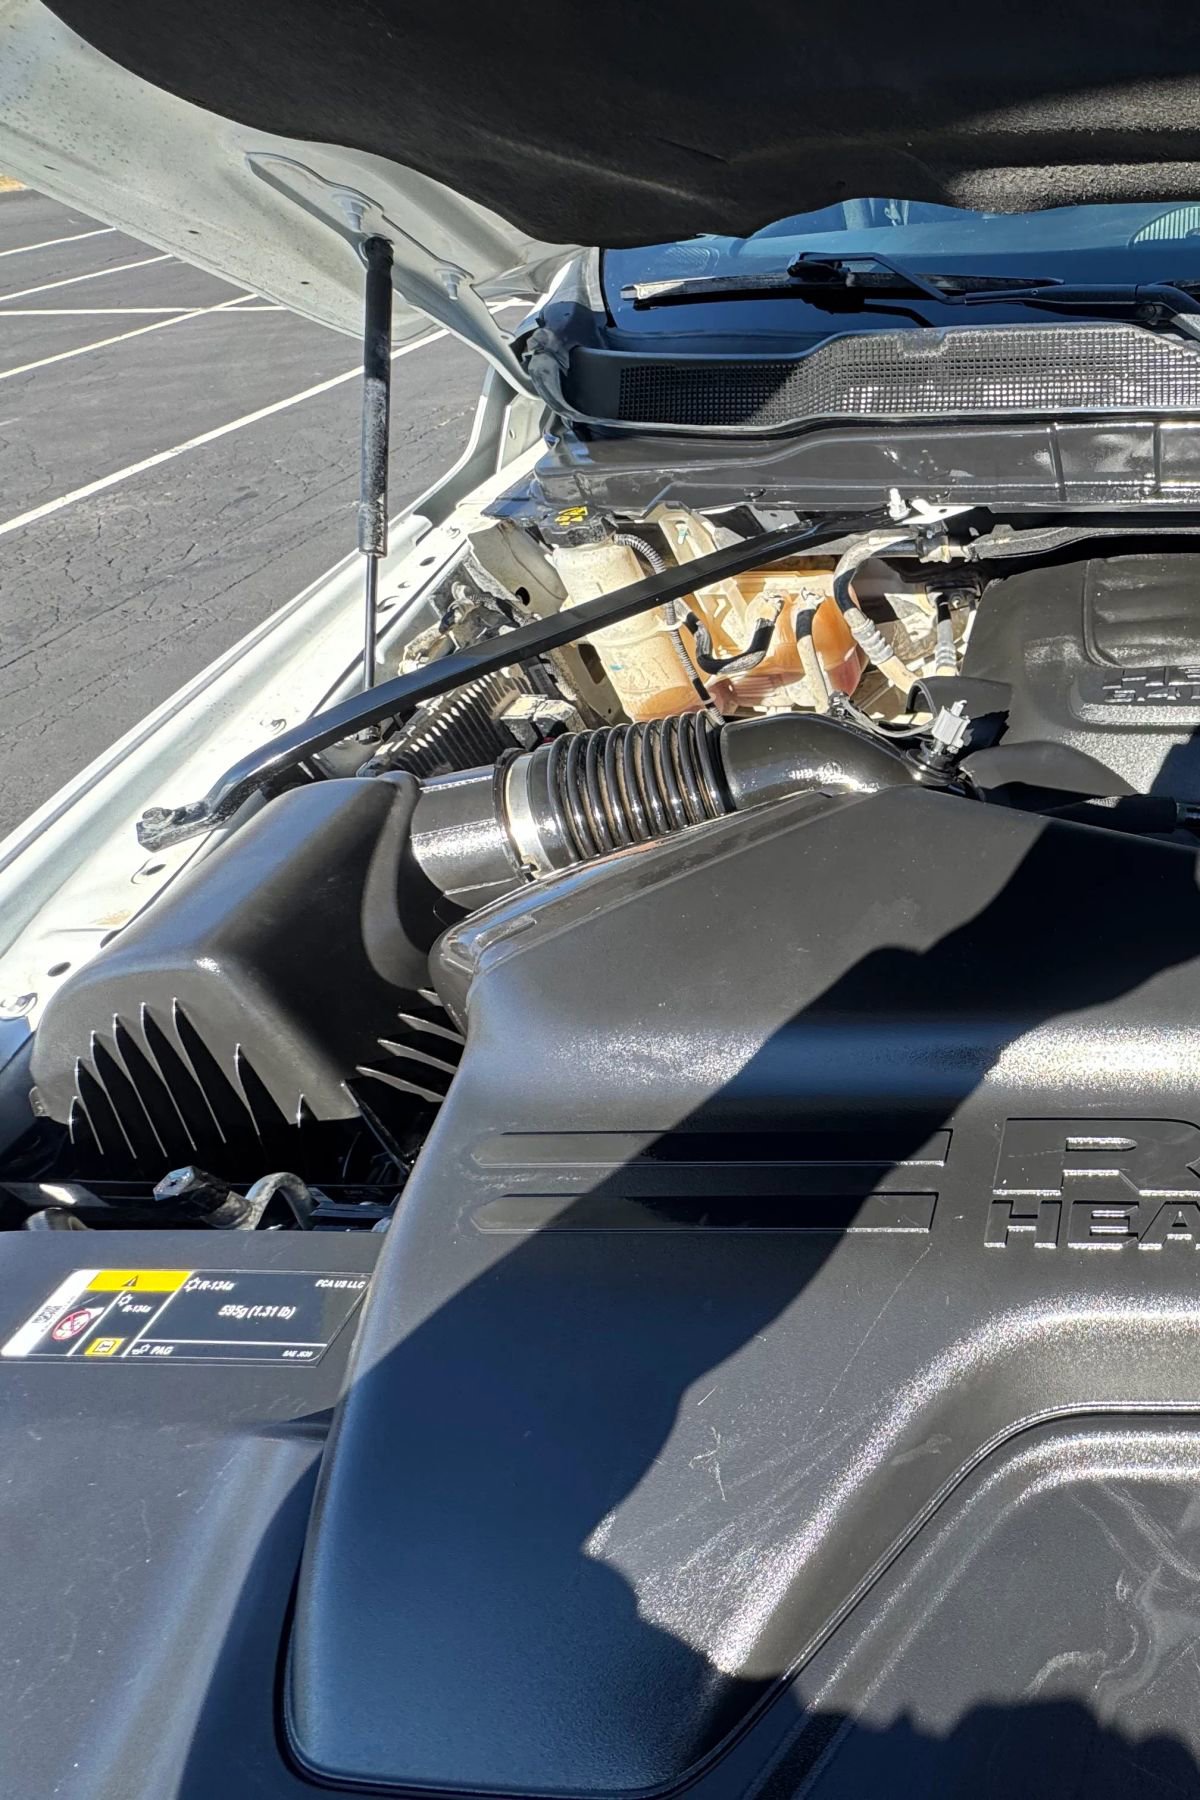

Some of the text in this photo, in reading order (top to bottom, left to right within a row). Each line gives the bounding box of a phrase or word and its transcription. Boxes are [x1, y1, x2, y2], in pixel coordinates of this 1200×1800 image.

[198, 1279, 236, 1291] R-134a
[315, 1279, 367, 1289] FCA US LLC
[218, 1304, 297, 1320] 595g (1.31 lb)
[151, 1346, 175, 1355] PAG
